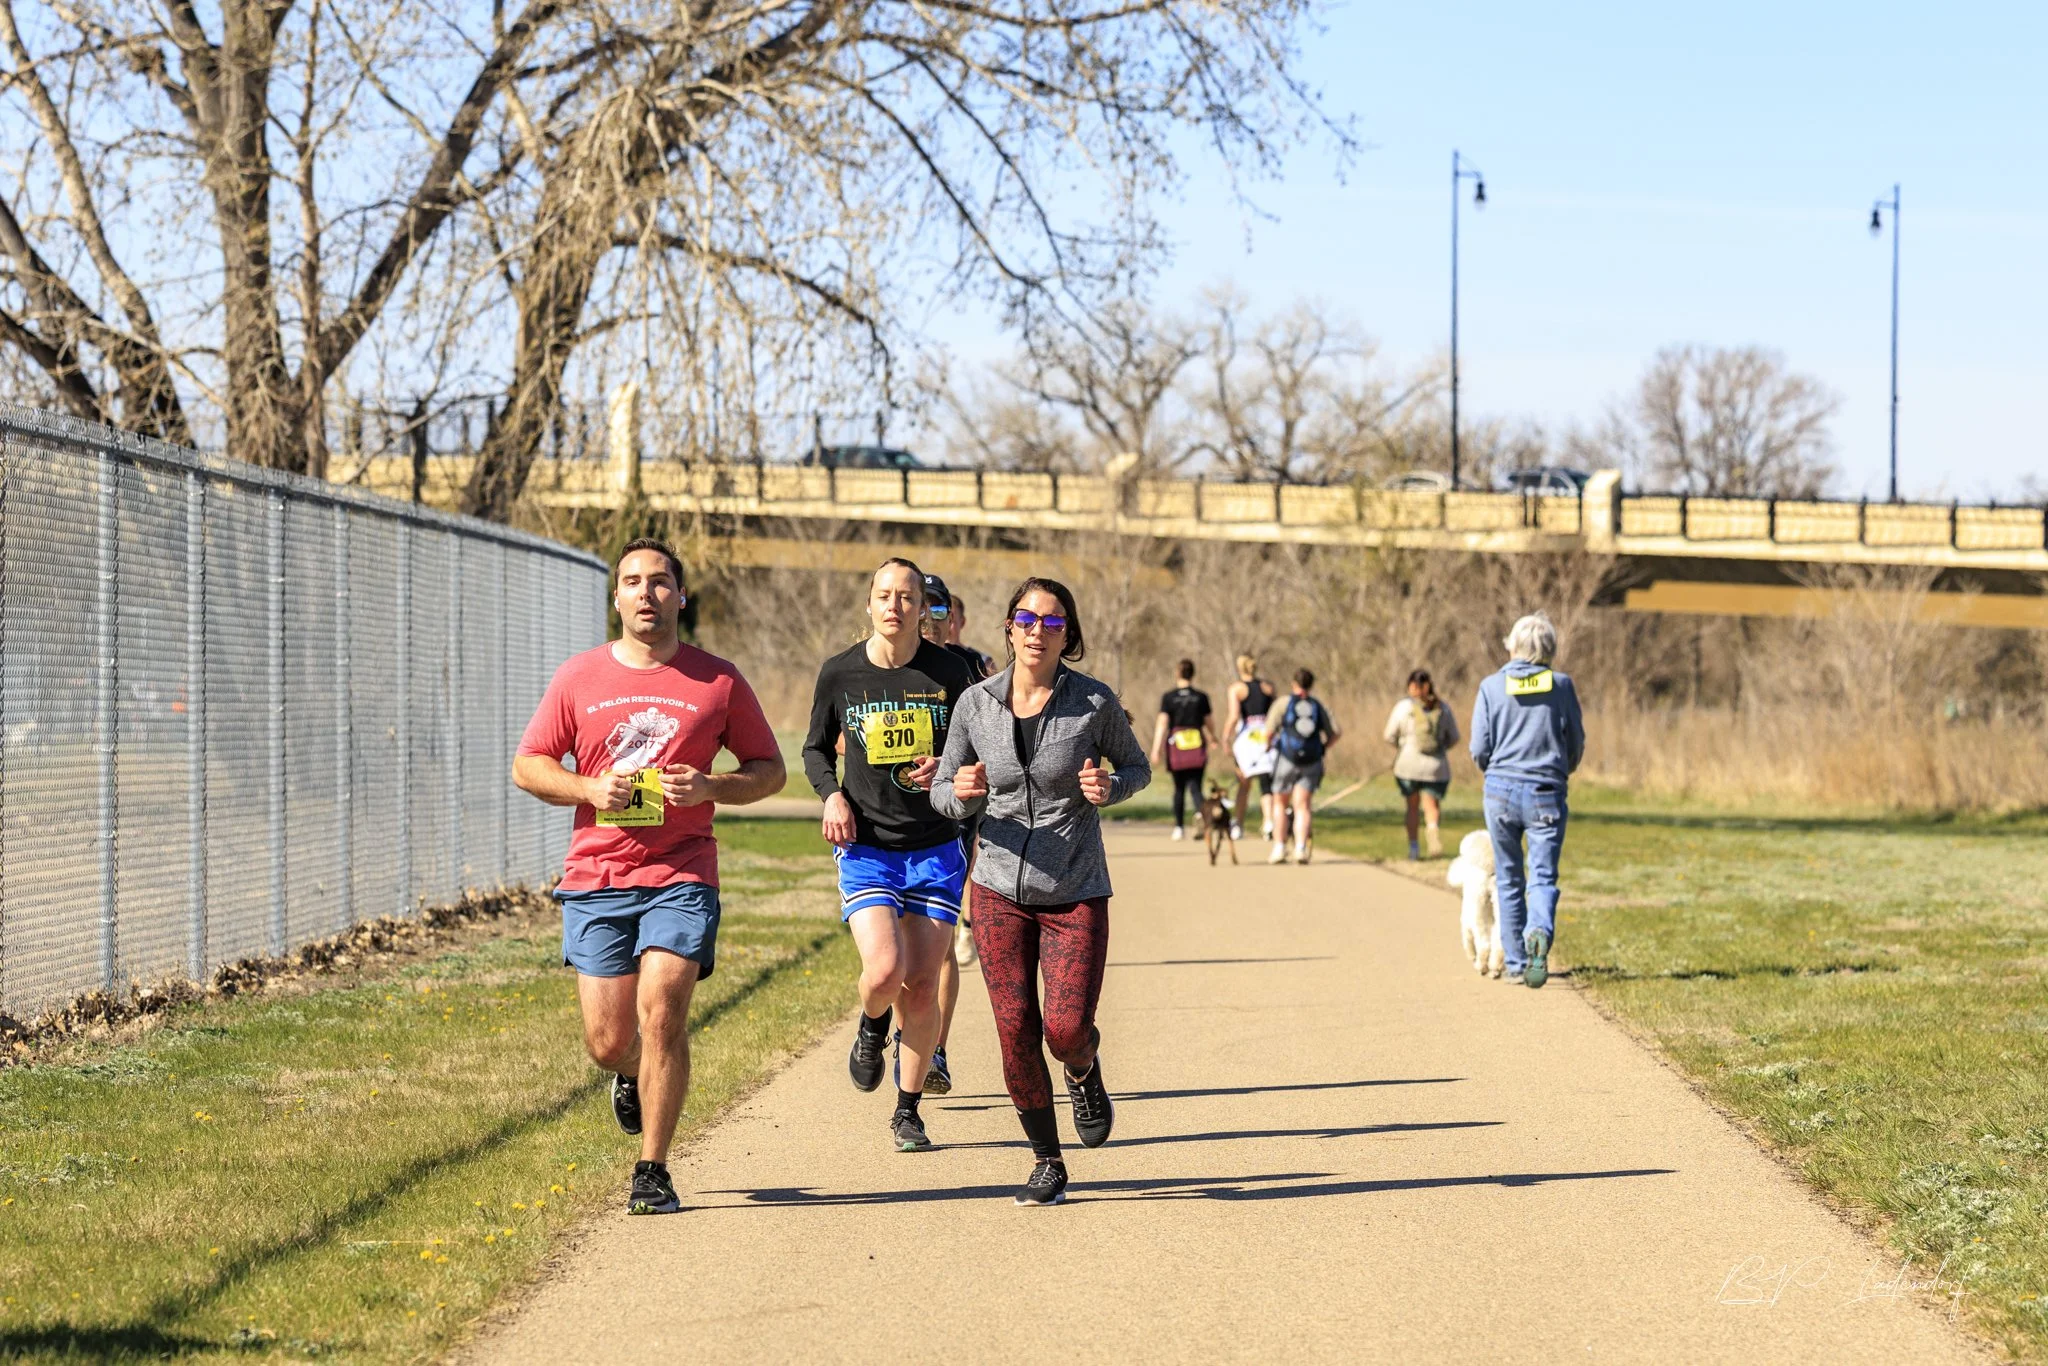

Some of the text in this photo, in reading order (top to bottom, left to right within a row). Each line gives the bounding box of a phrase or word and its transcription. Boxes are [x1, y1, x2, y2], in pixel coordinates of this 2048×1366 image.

[586, 696, 700, 714] EL PELÓN RESERVOIR 5K
[901, 712, 916, 724] 5K
[627, 740, 656, 749] 2017
[883, 728, 915, 749] 370
